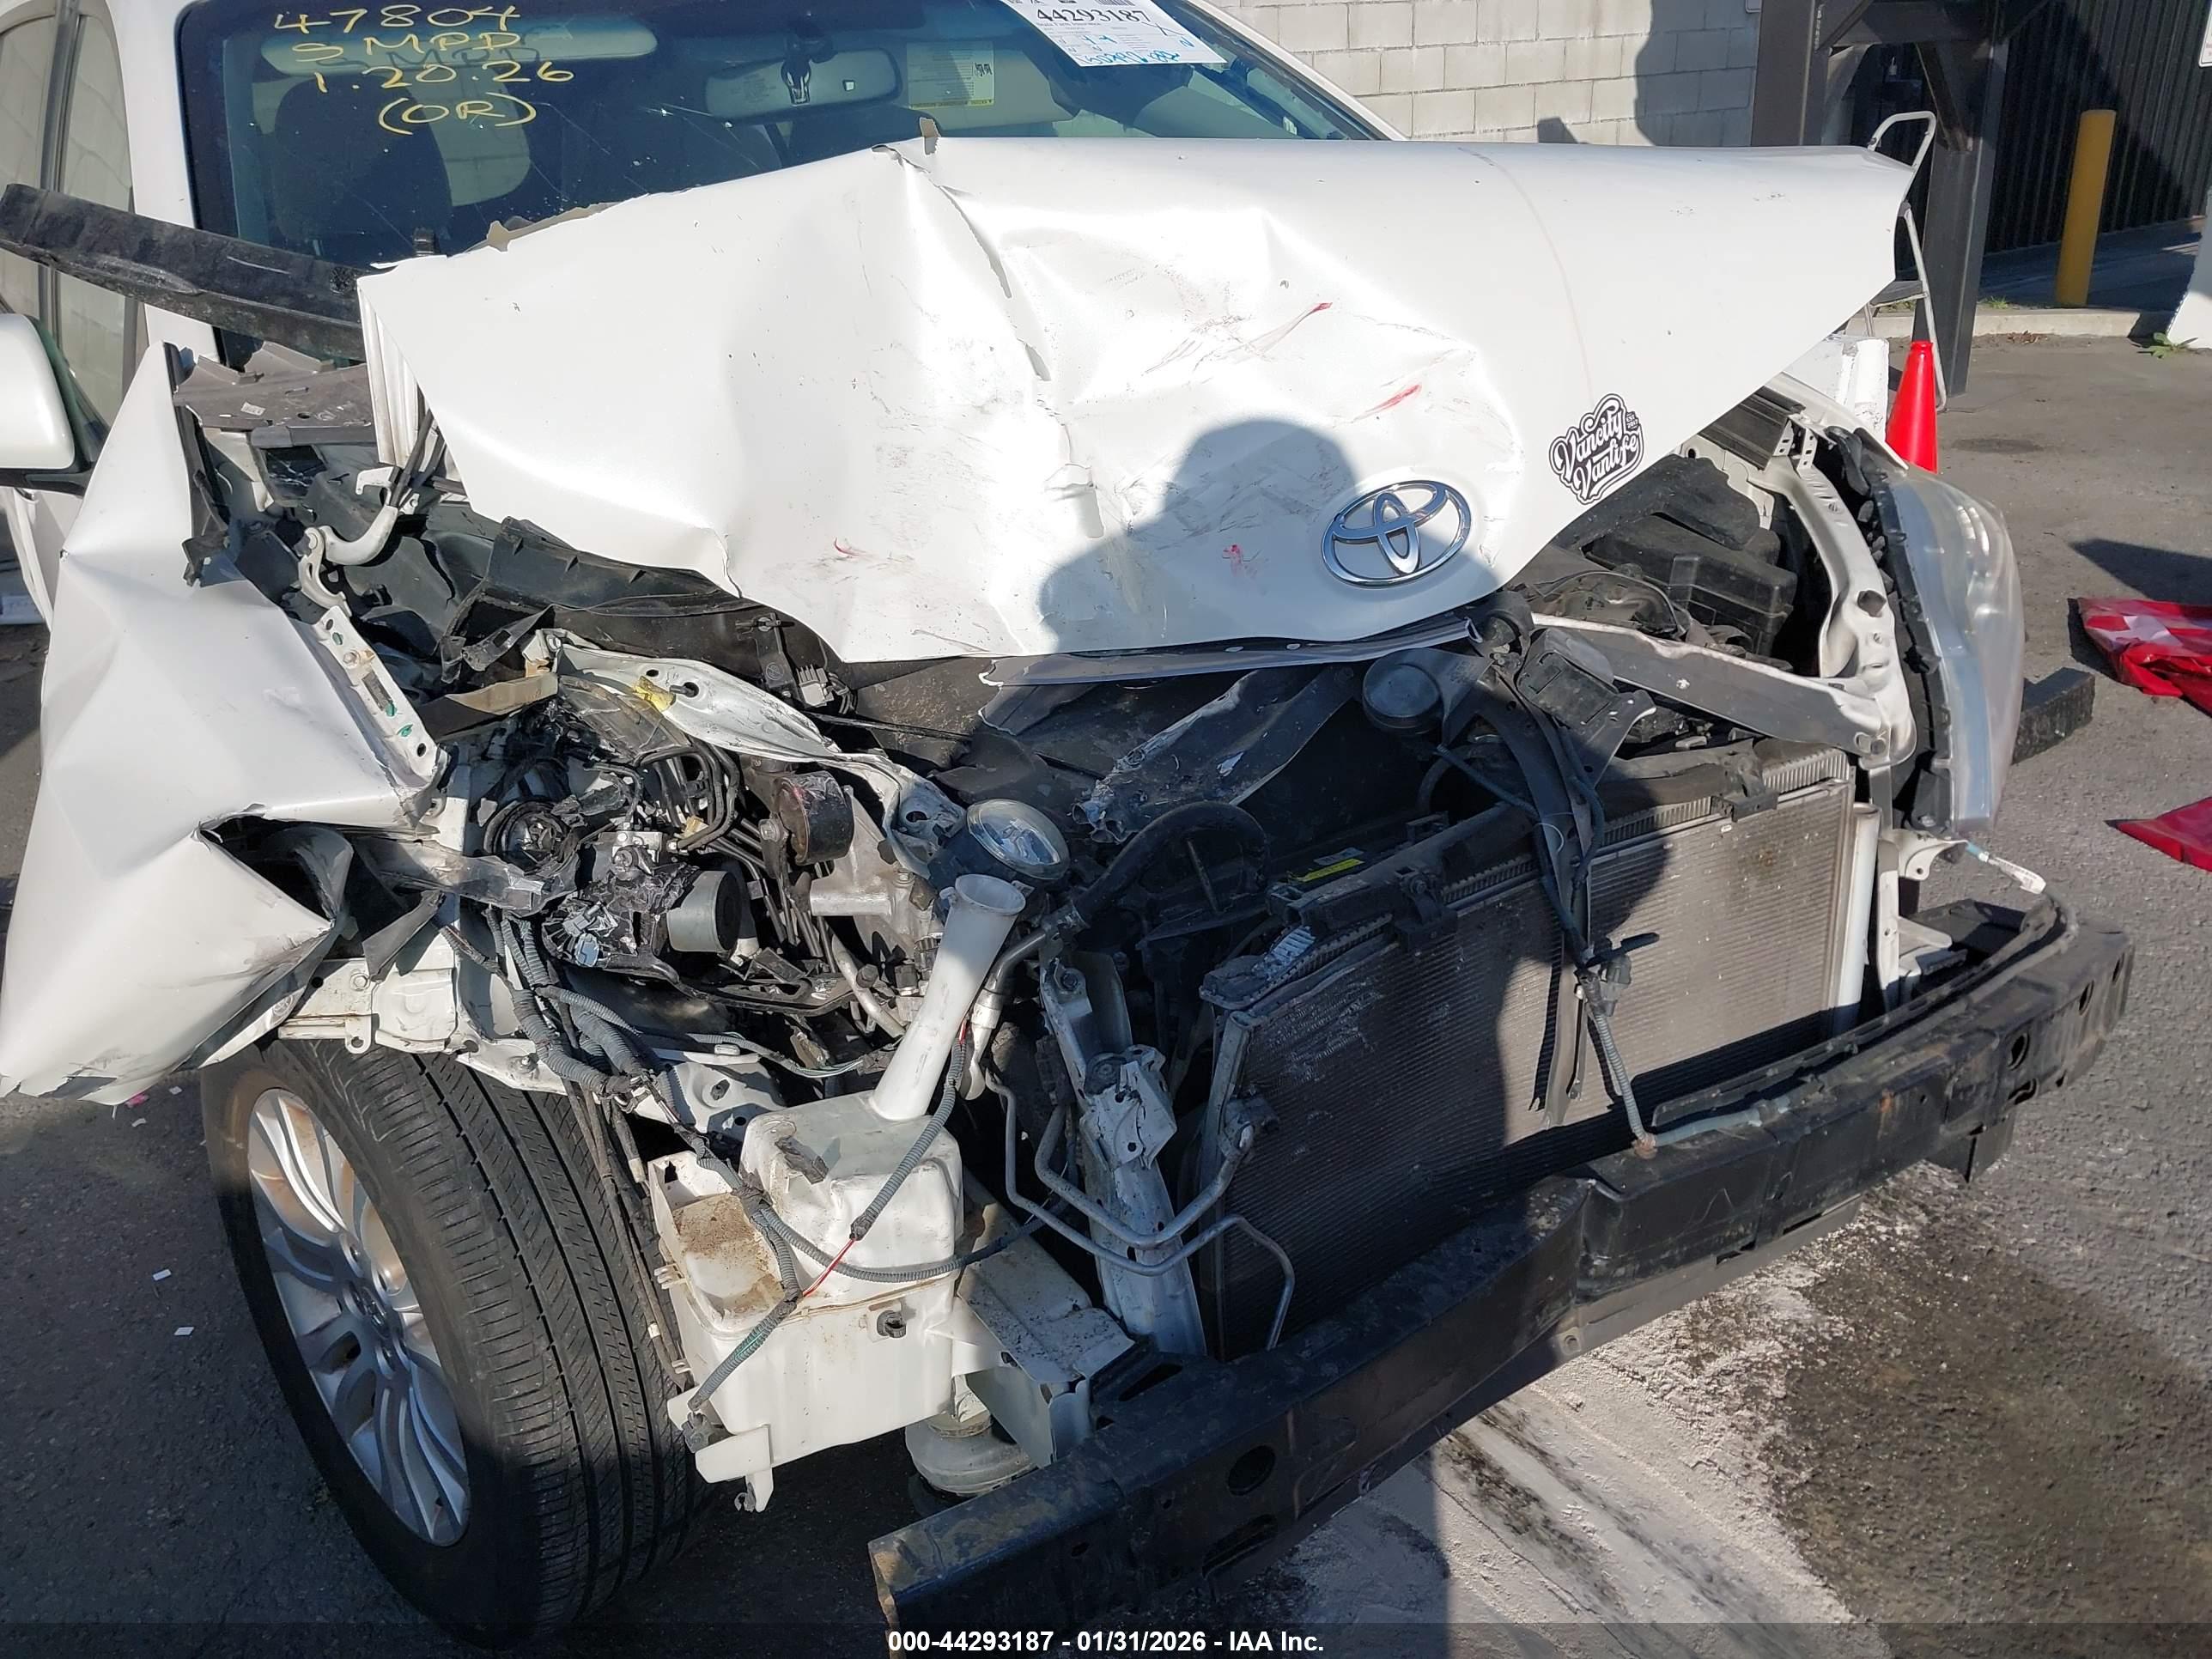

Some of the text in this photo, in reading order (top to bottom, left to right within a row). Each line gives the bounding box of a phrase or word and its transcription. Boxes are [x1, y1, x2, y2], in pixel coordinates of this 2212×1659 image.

[274, 4, 520, 33] 47804
[1036, 9, 1153, 22] 44293187
[378, 92, 537, 136] (OR)
[1553, 398, 1623, 483] Vancity
[1572, 434, 1638, 500] Vanlife
